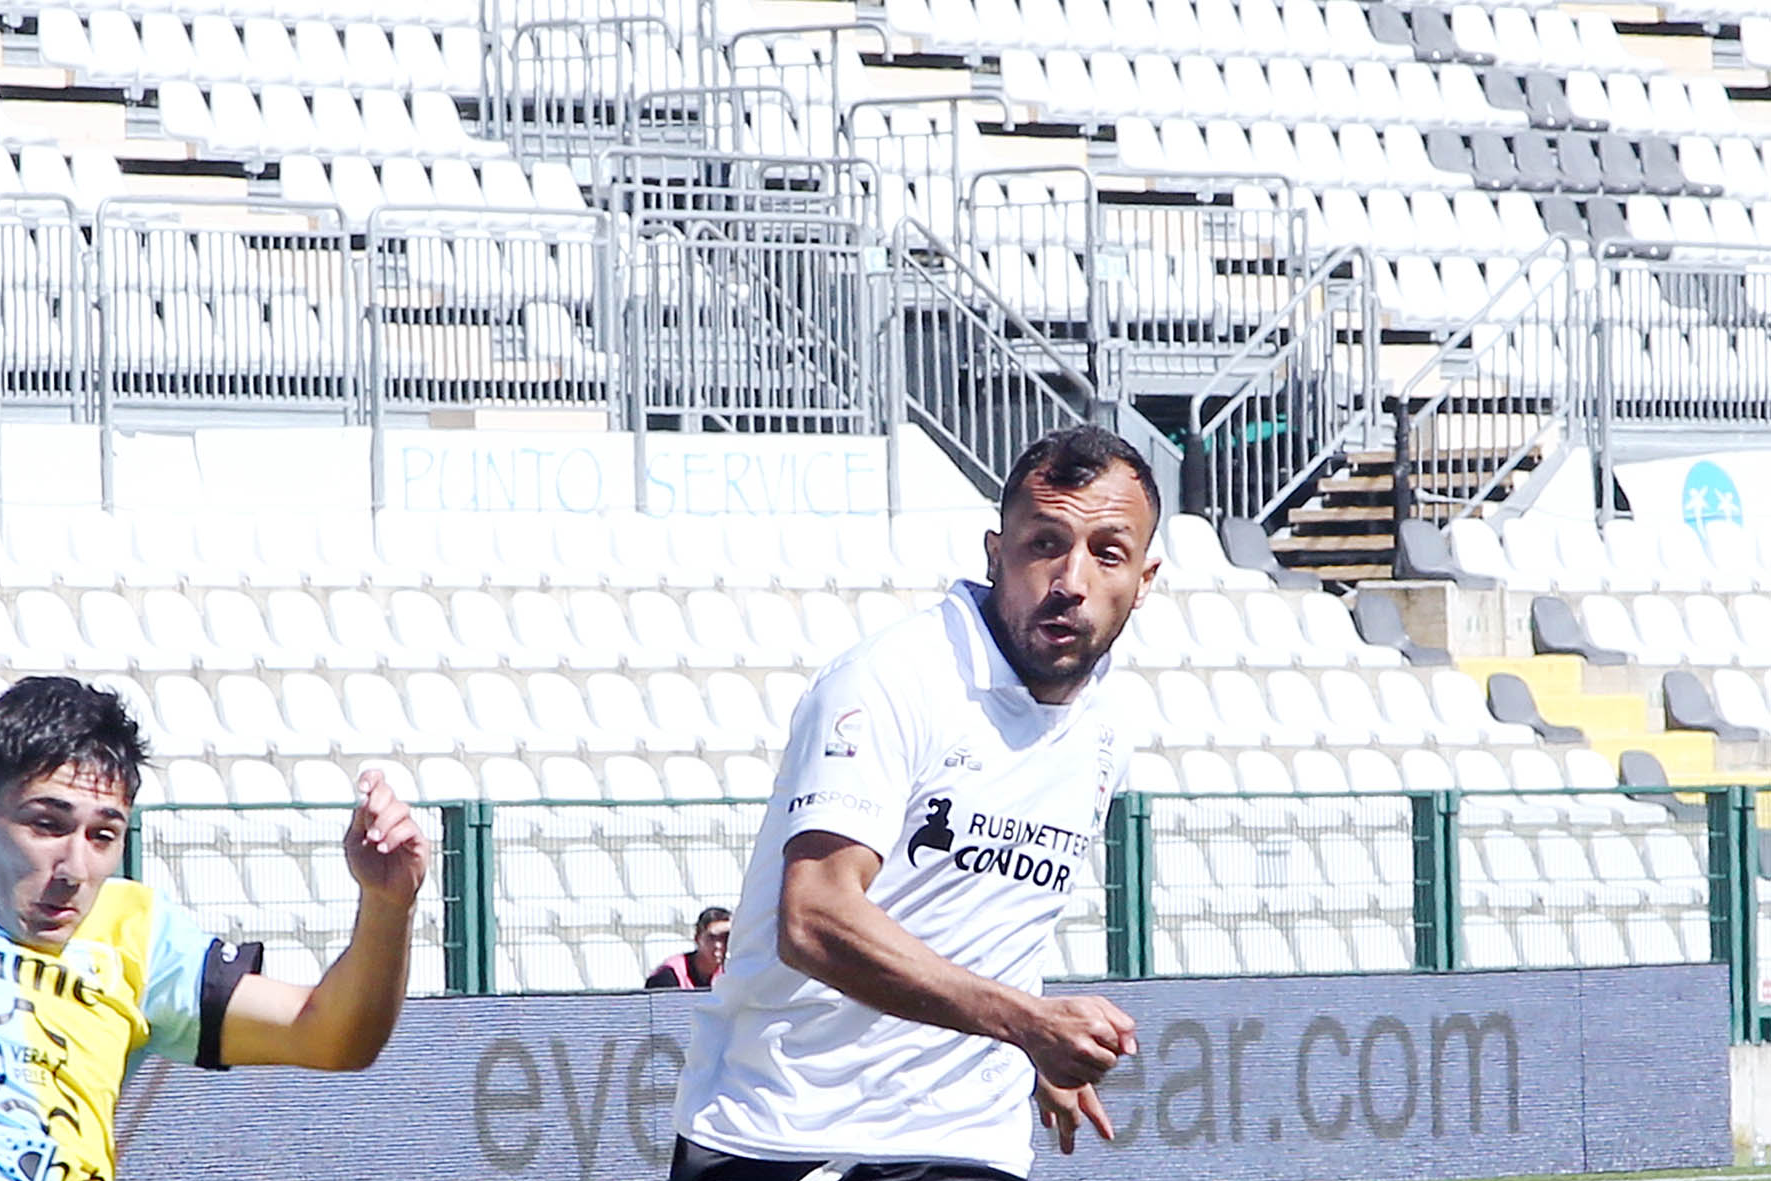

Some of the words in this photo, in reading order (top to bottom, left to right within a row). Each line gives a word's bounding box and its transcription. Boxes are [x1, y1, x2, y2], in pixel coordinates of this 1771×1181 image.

[402, 446, 605, 514] PUNTO
[644, 450, 883, 519] SERVICE
[954, 845, 1072, 893] CONDOR
